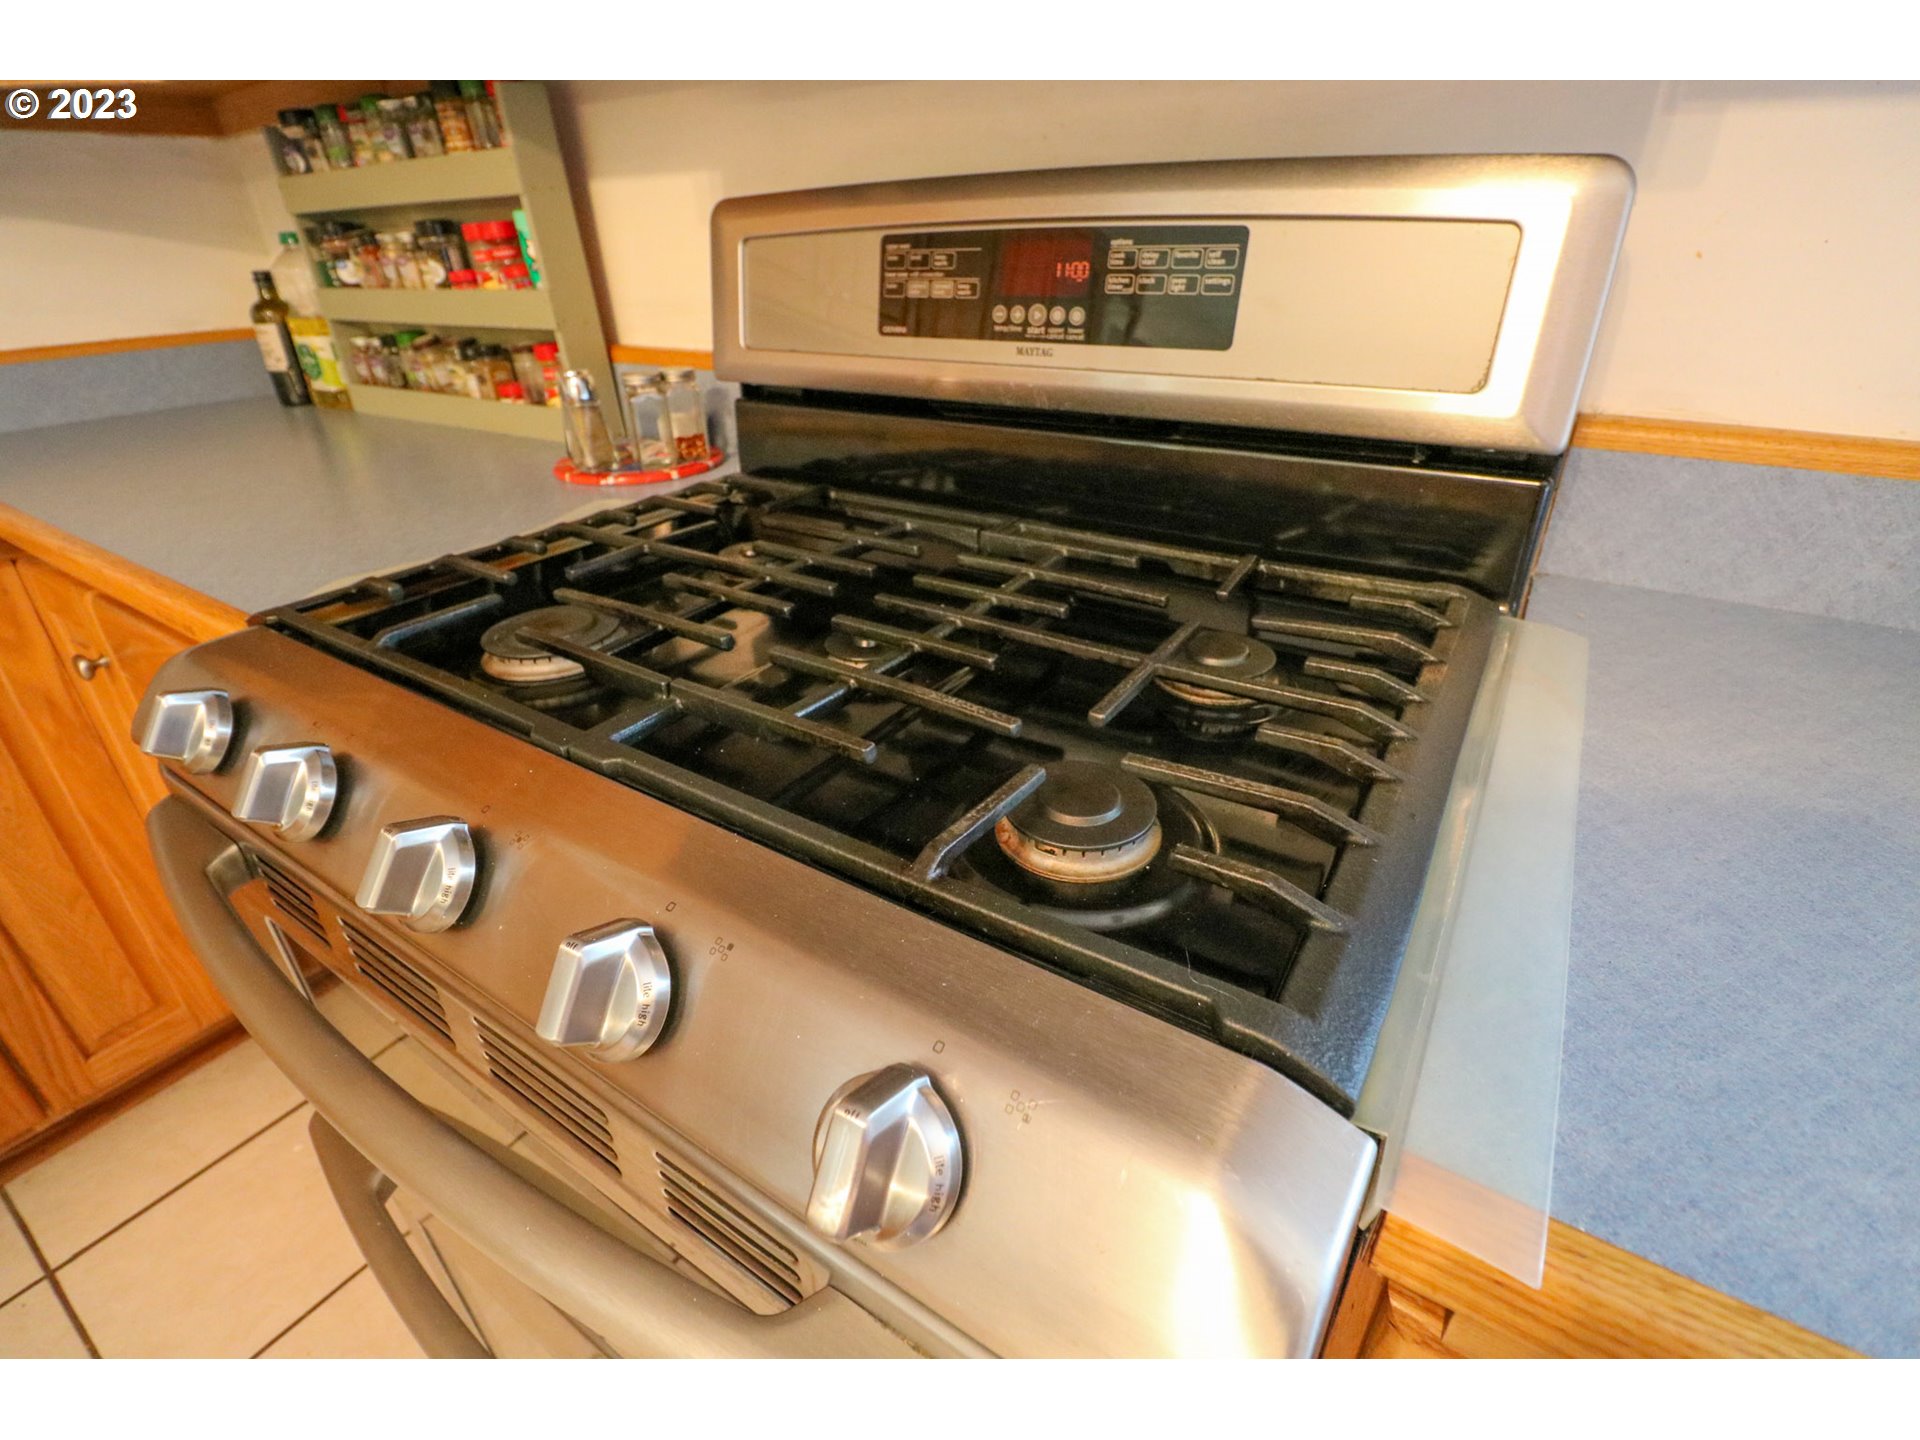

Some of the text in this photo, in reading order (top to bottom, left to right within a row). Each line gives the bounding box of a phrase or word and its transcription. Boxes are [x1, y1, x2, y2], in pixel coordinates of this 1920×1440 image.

[1016, 346, 1054, 357] MAYTAG
[637, 1003, 651, 1027] high
[928, 1155, 945, 1213] lite high
